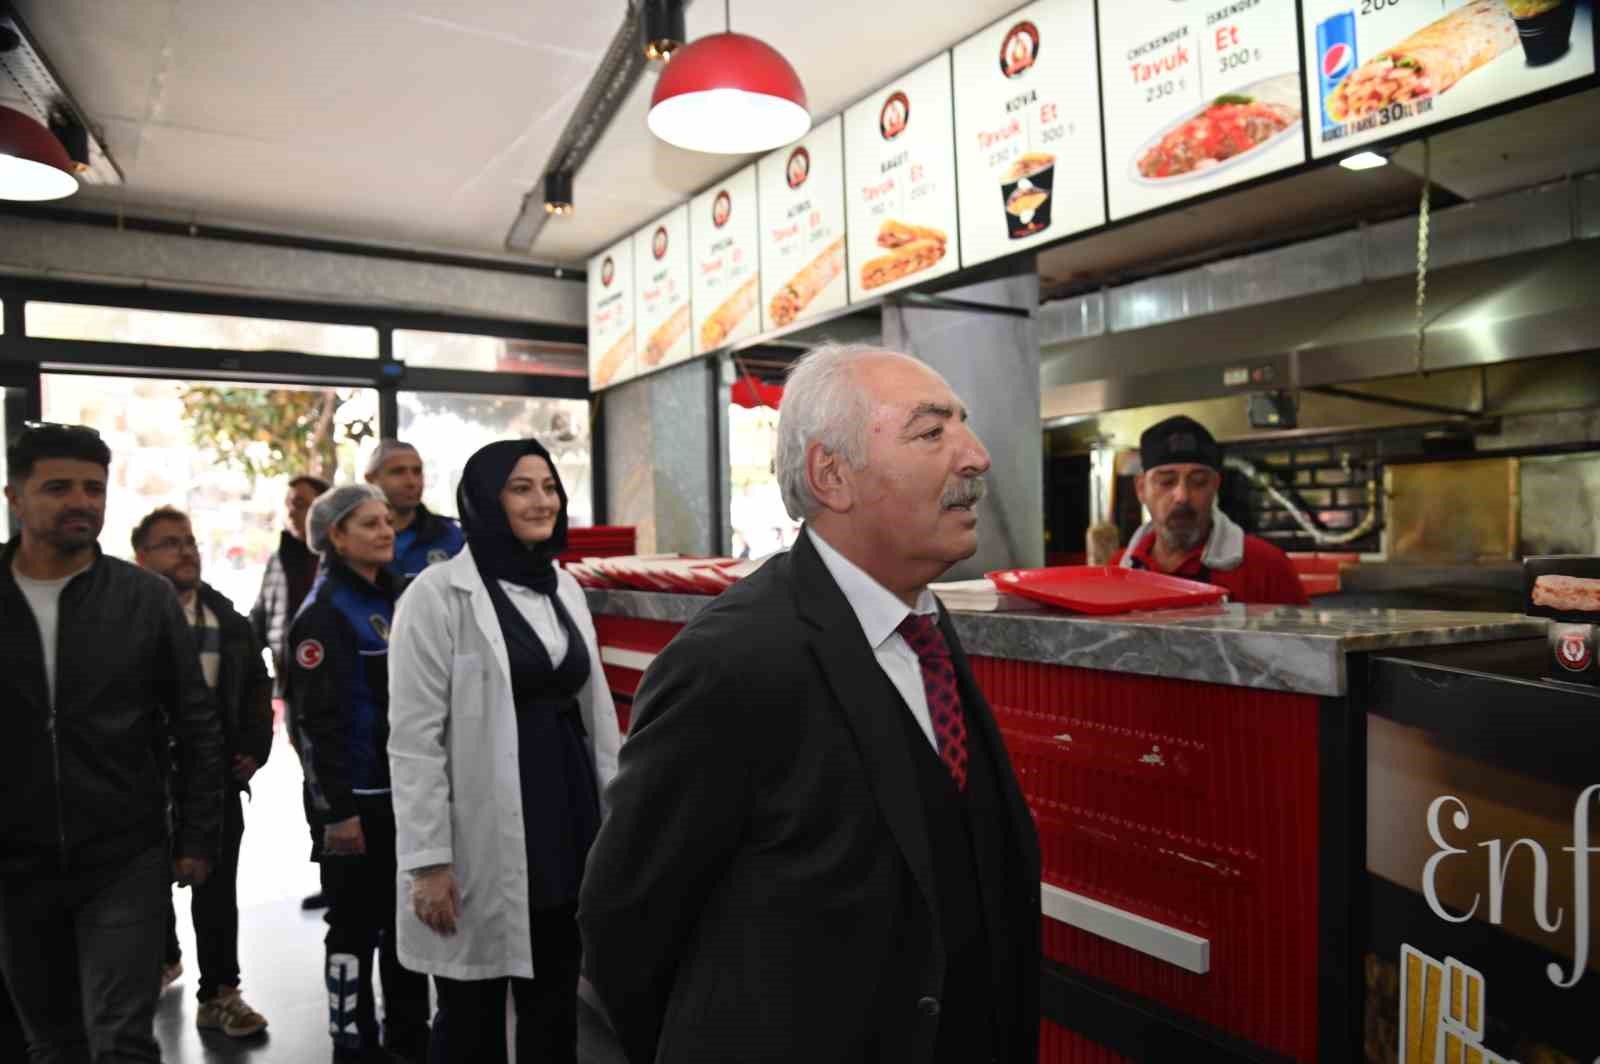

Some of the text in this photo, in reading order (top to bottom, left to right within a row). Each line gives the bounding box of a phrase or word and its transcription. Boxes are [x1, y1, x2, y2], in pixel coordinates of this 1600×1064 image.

[1215, 24, 1239, 52] Et
[1130, 46, 1189, 82] Tavuk
[1219, 48, 1250, 74] 300
[1146, 80, 1175, 104] 230
[1040, 102, 1057, 126] Et
